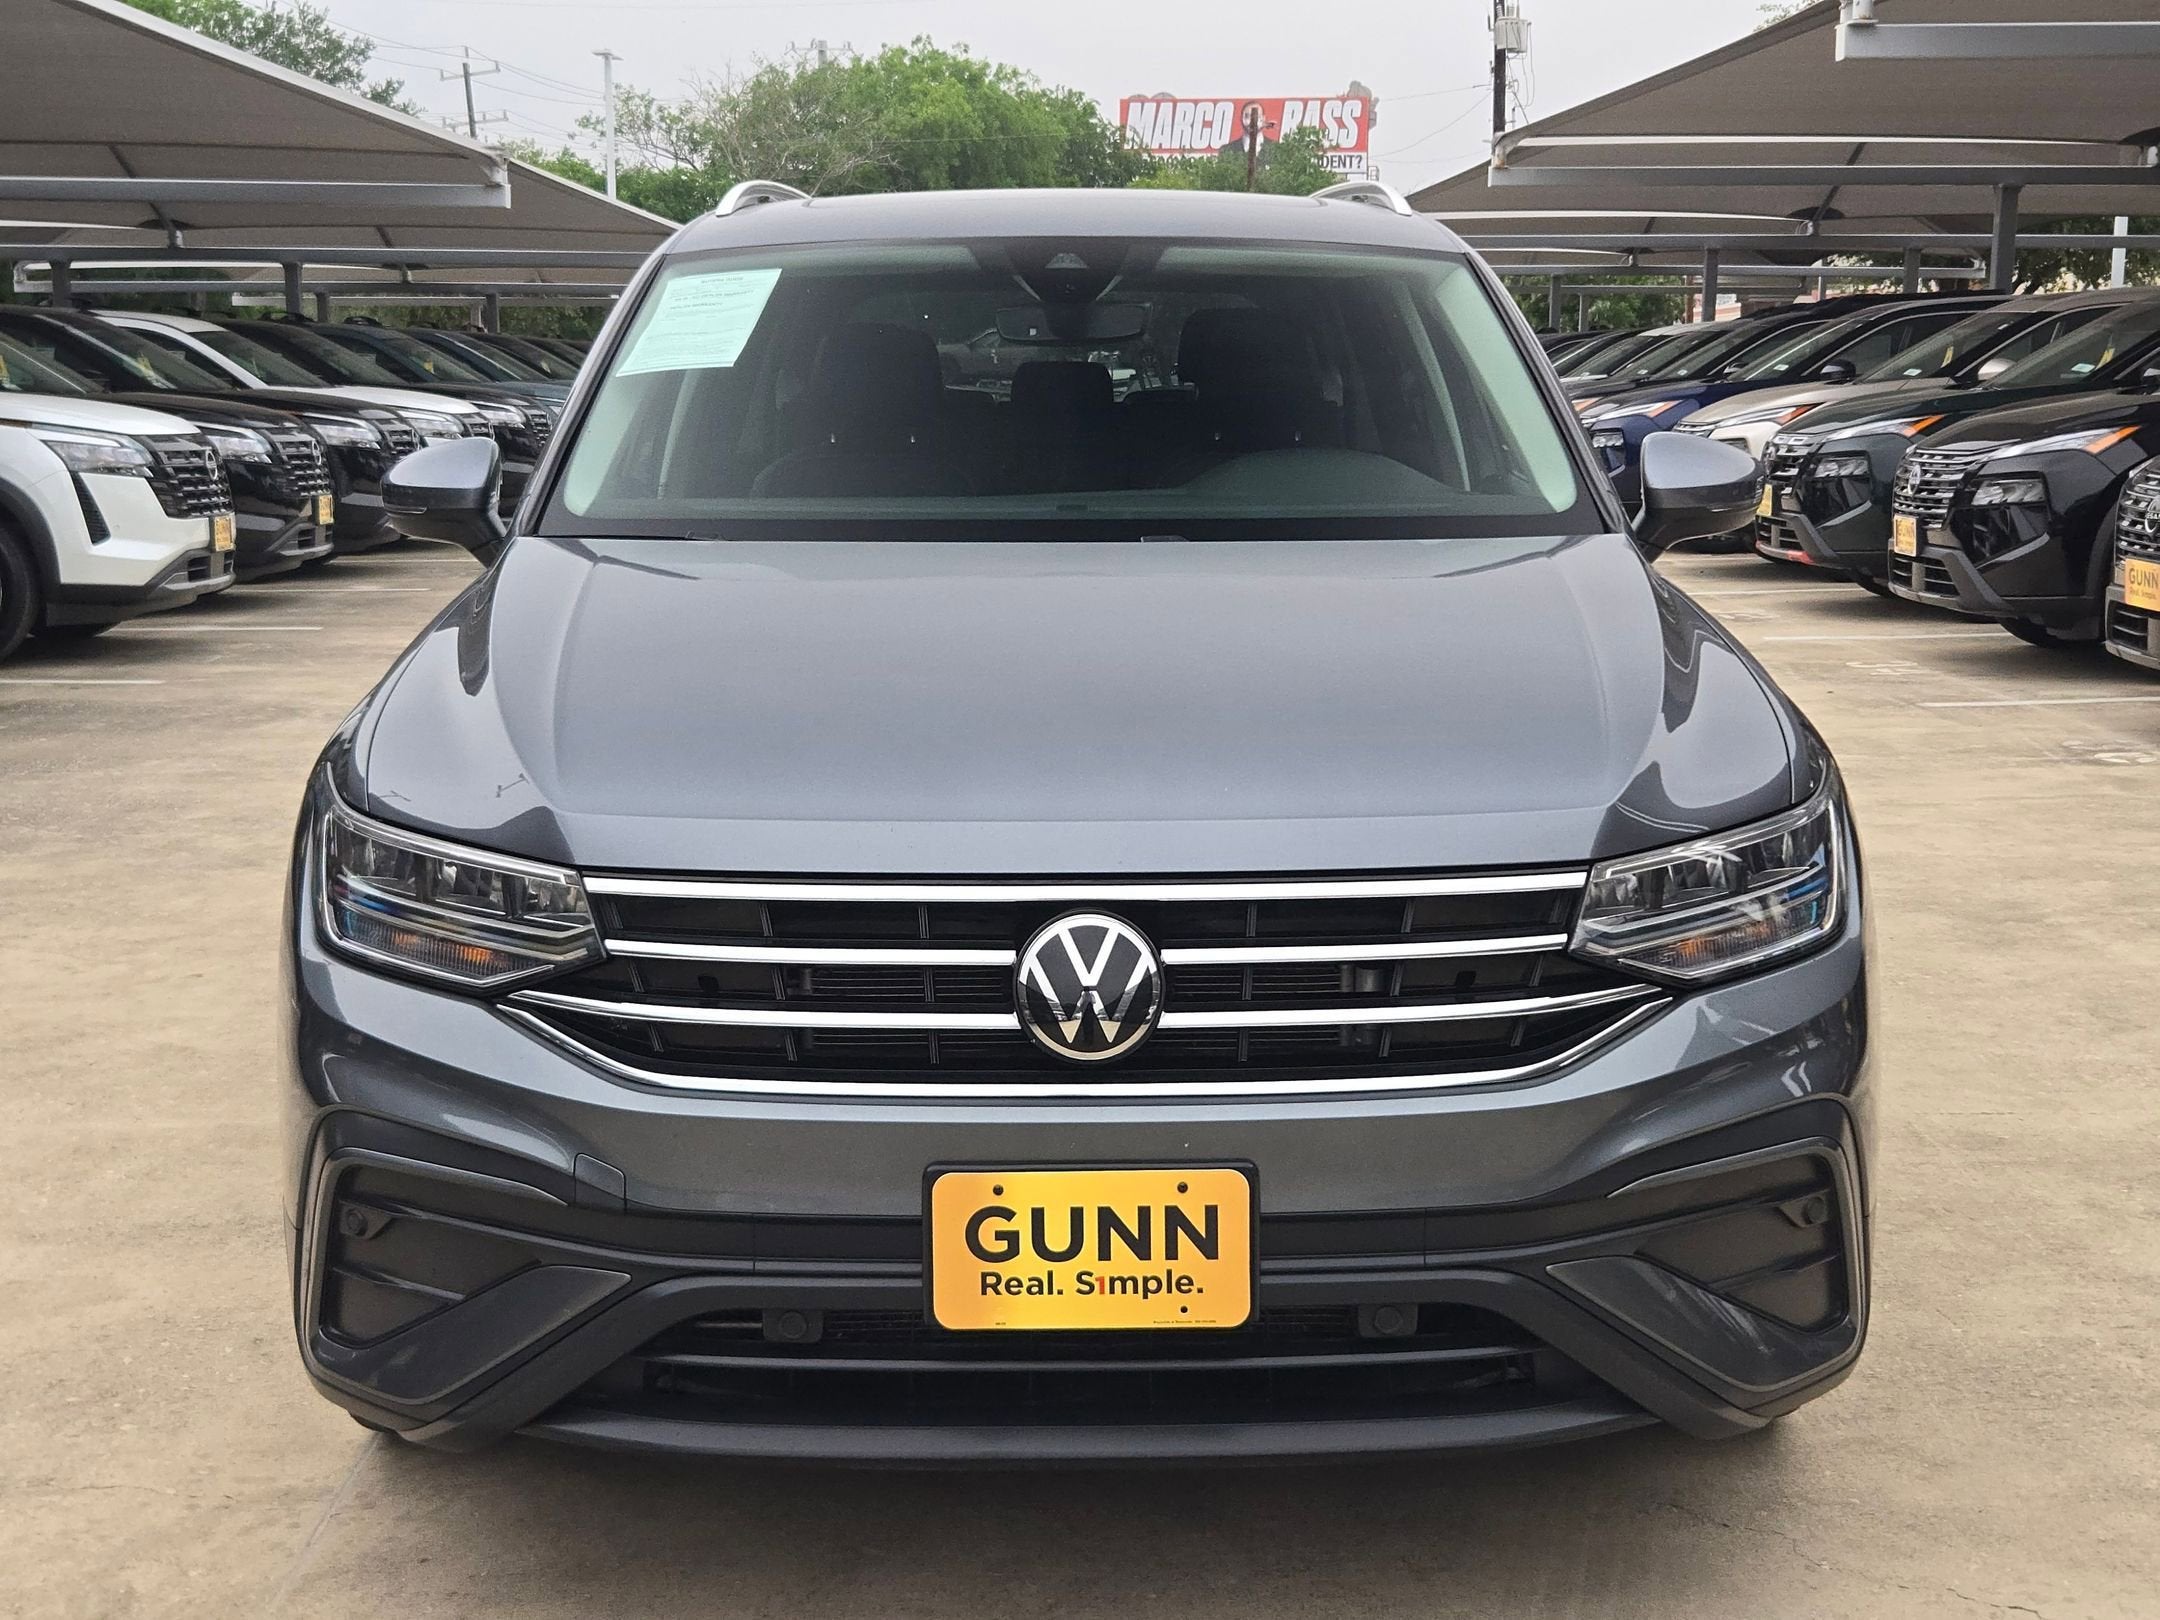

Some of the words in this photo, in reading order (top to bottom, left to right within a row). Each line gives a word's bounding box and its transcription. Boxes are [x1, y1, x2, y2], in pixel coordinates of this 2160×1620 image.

[1123, 101, 1234, 149] MARCO
[2129, 567, 2159, 590] GUNN
[965, 1204, 1219, 1263] GUNN
[980, 1270, 1064, 1296] Real.
